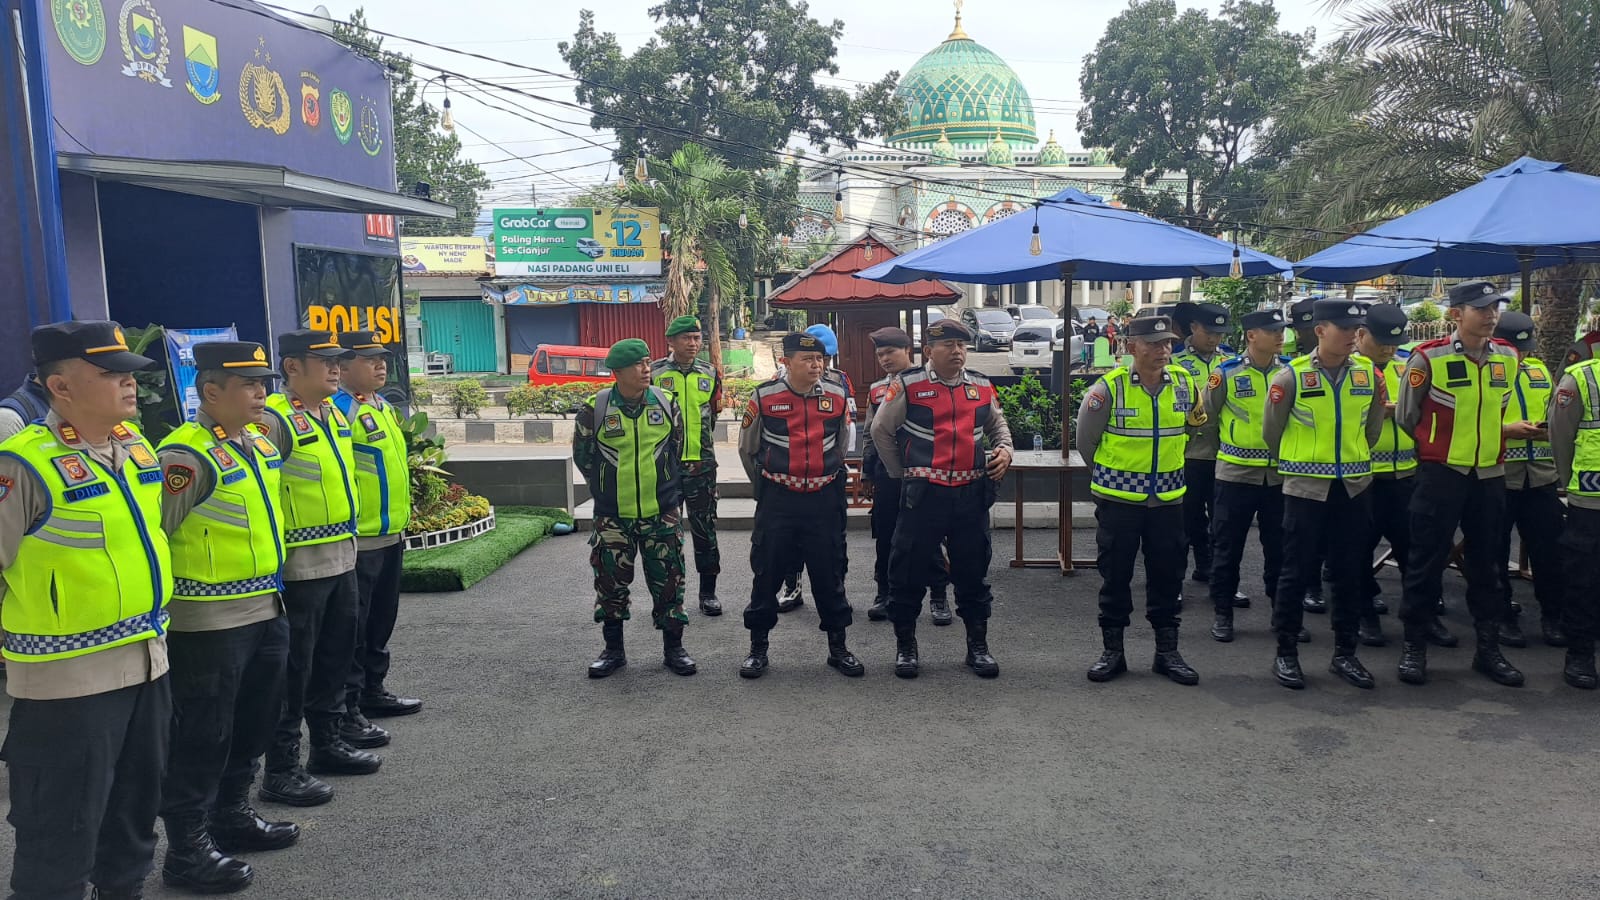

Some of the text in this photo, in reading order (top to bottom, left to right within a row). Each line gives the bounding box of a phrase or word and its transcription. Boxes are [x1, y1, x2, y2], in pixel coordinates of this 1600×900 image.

[367, 214, 393, 236] 110
[500, 217, 550, 228] GrabCar
[611, 219, 642, 247] 12
[502, 235, 565, 245] Paling Hemat
[502, 246, 550, 256] Se-Cianjur
[527, 264, 630, 273] NASI PADANG UNI ELI
[524, 289, 568, 302] UNI
[308, 304, 400, 344] POLISI
